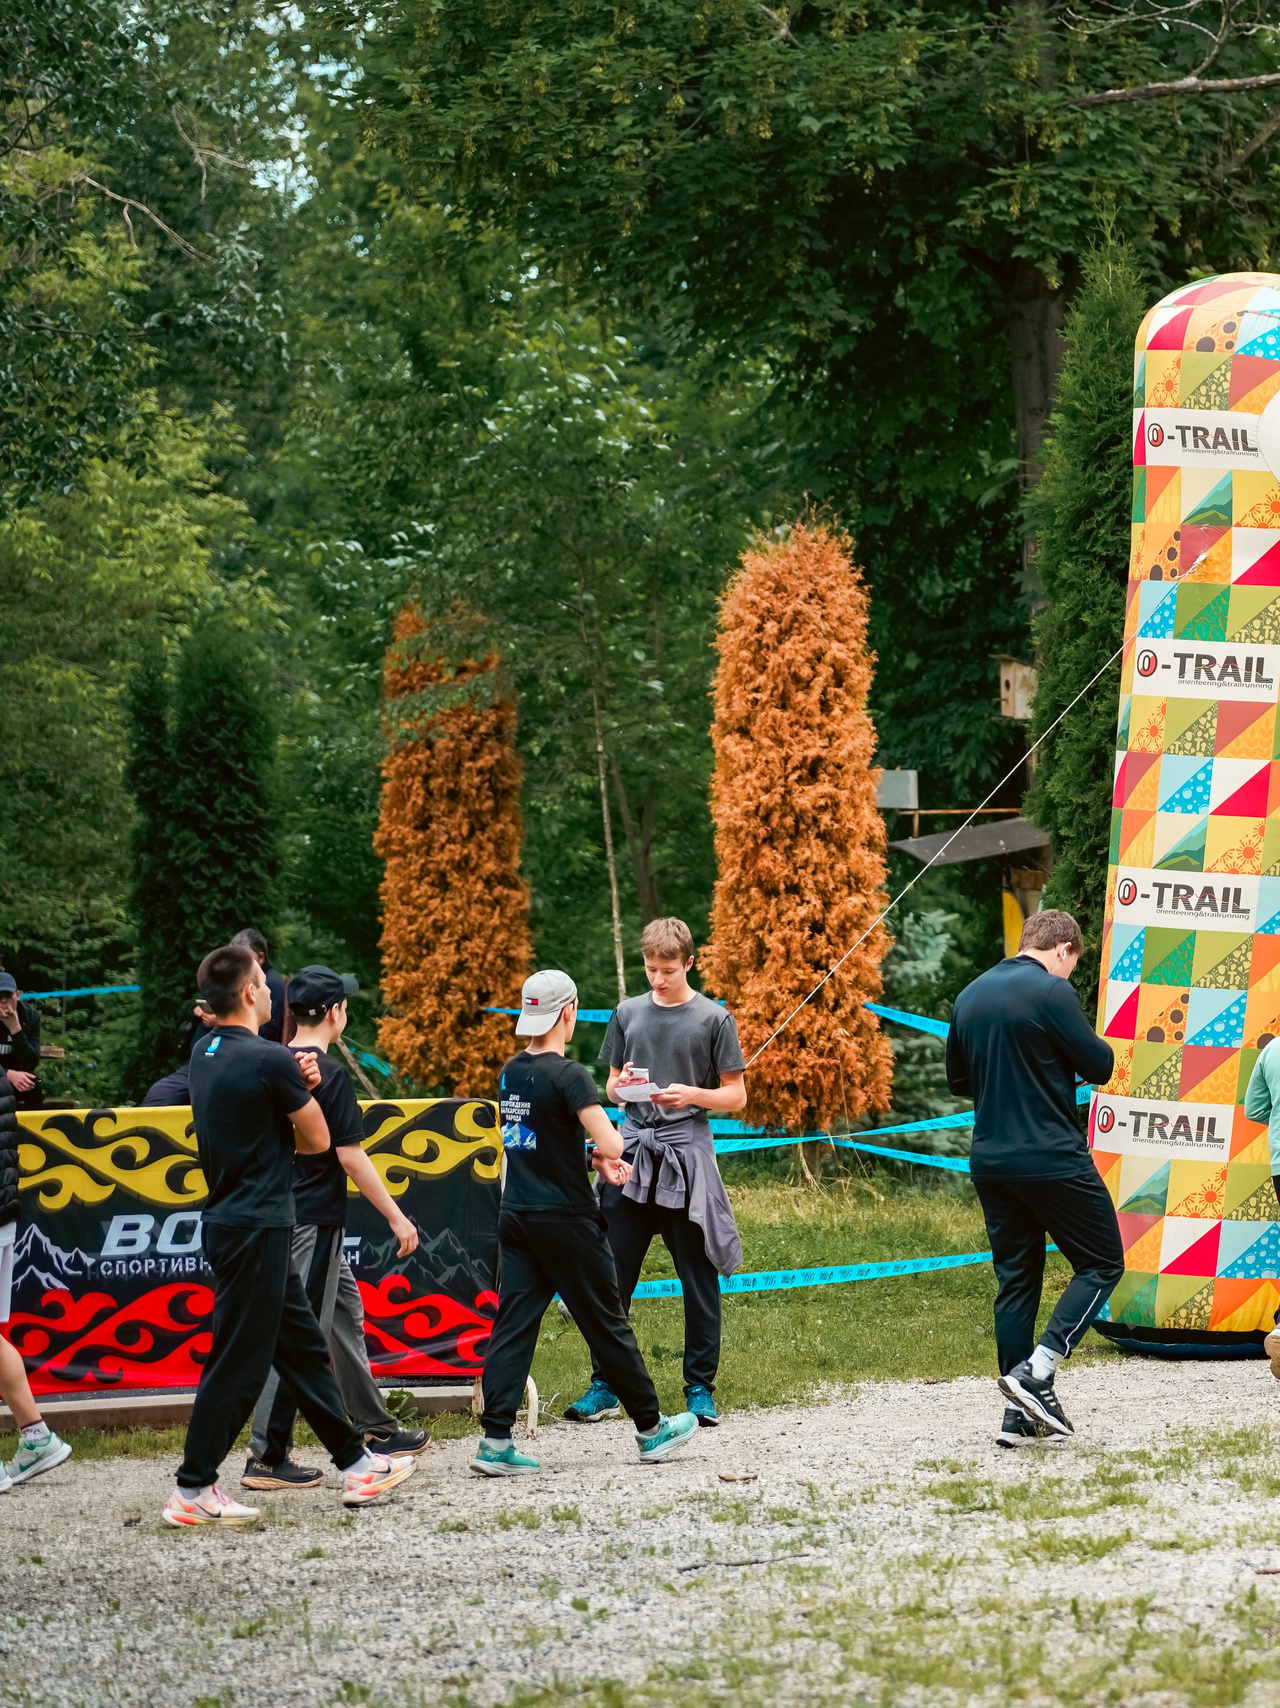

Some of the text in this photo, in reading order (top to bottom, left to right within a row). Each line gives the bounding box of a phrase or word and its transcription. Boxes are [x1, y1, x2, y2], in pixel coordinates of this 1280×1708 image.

[1178, 679, 1273, 690] orienteering&trailrunning
[1156, 908, 1250, 921] orienteering&trailrunning
[1132, 1137, 1224, 1150] orienteering&trailrunning
[100, 1256, 213, 1275] СПОРТИВН
[253, 1461, 274, 1473] HOKA
